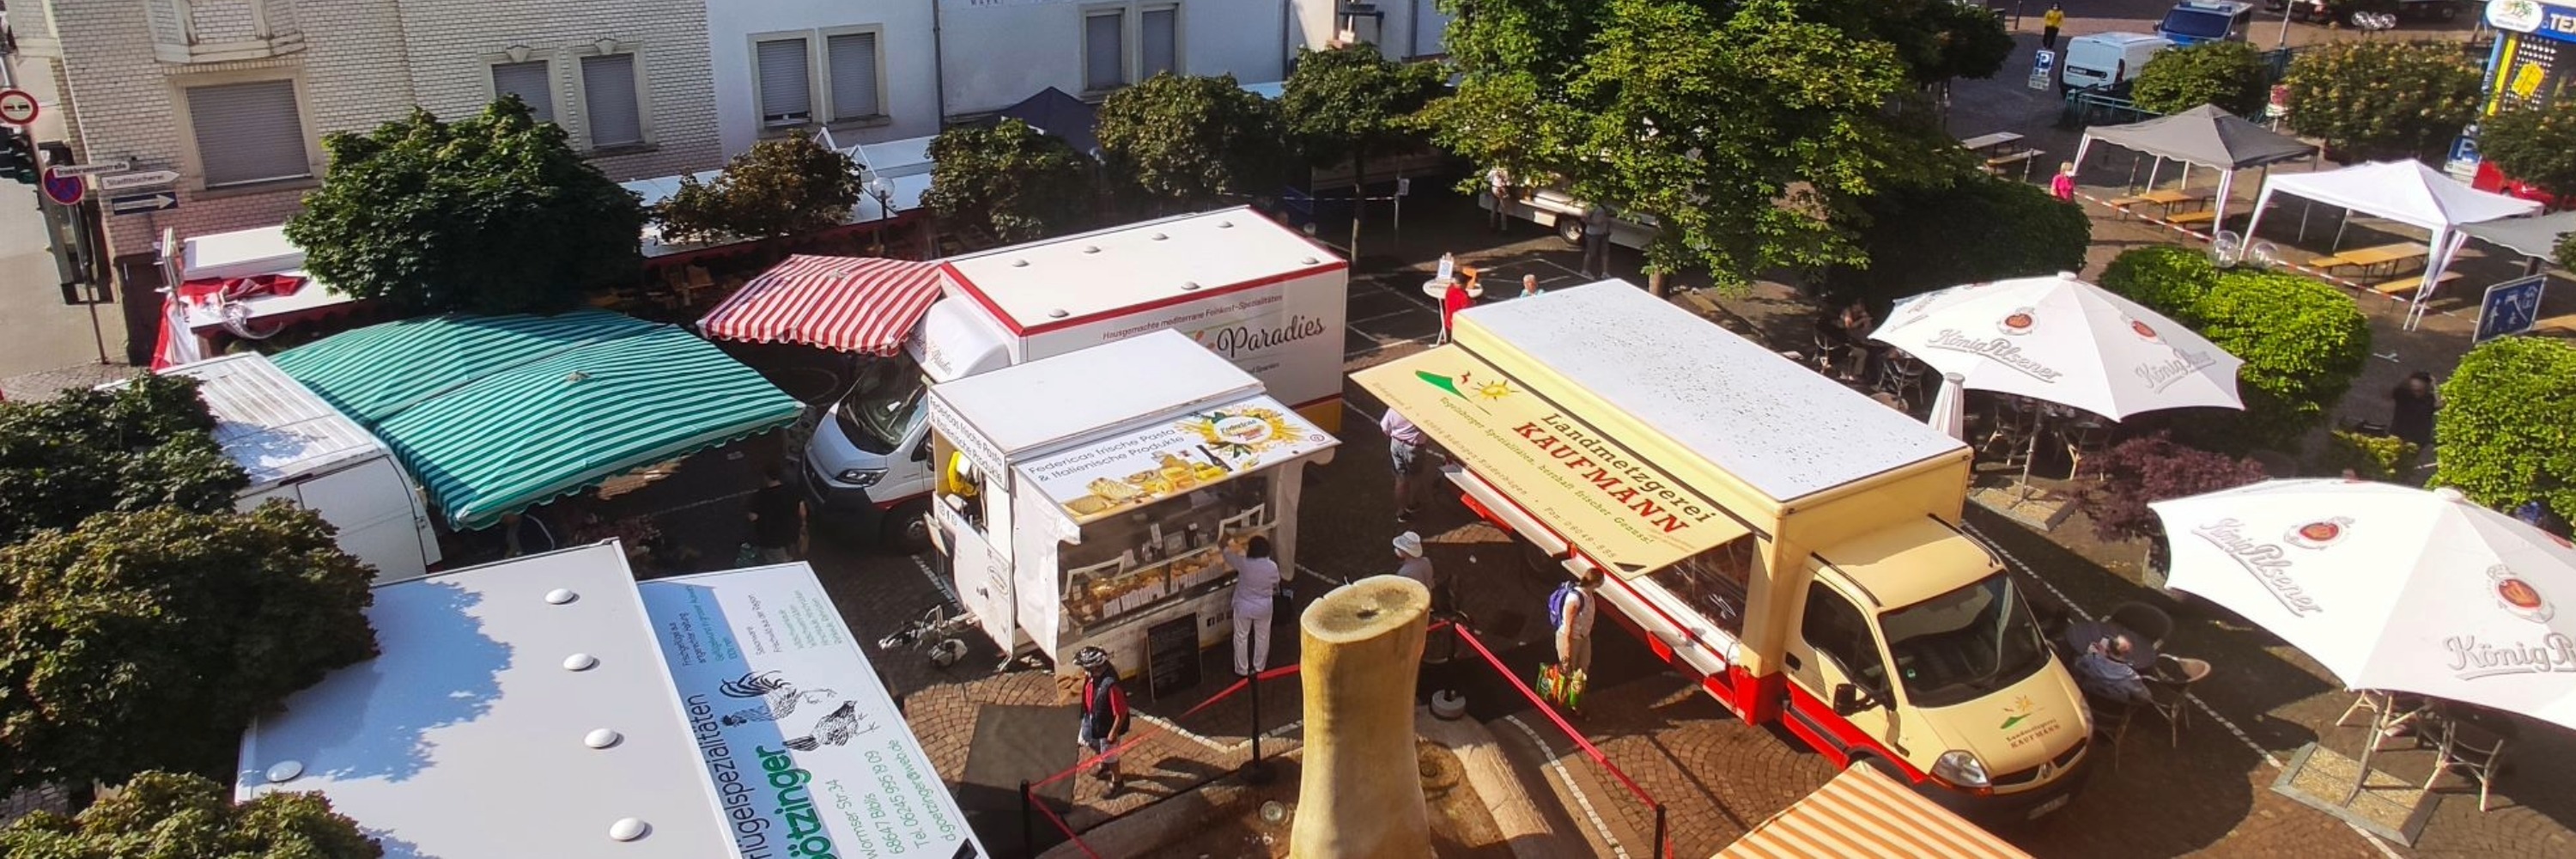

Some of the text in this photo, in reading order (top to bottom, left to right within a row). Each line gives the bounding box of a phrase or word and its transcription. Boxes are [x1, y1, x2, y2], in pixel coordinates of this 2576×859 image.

[2549, 13, 2576, 33] TE
[1103, 321, 1160, 340] Hausgemachte
[1217, 314, 1326, 358] Paradies
[1029, 430, 1176, 475] Federicas frische Pasta
[1052, 454, 1127, 478] Italienische
[1128, 436, 1185, 456] Produkte
[1541, 412, 1716, 523] Landmetzgerei
[1512, 422, 1690, 533] KAUFMANN
[2443, 635, 2551, 673] König
[2010, 724, 2061, 748] KAUFMANN
